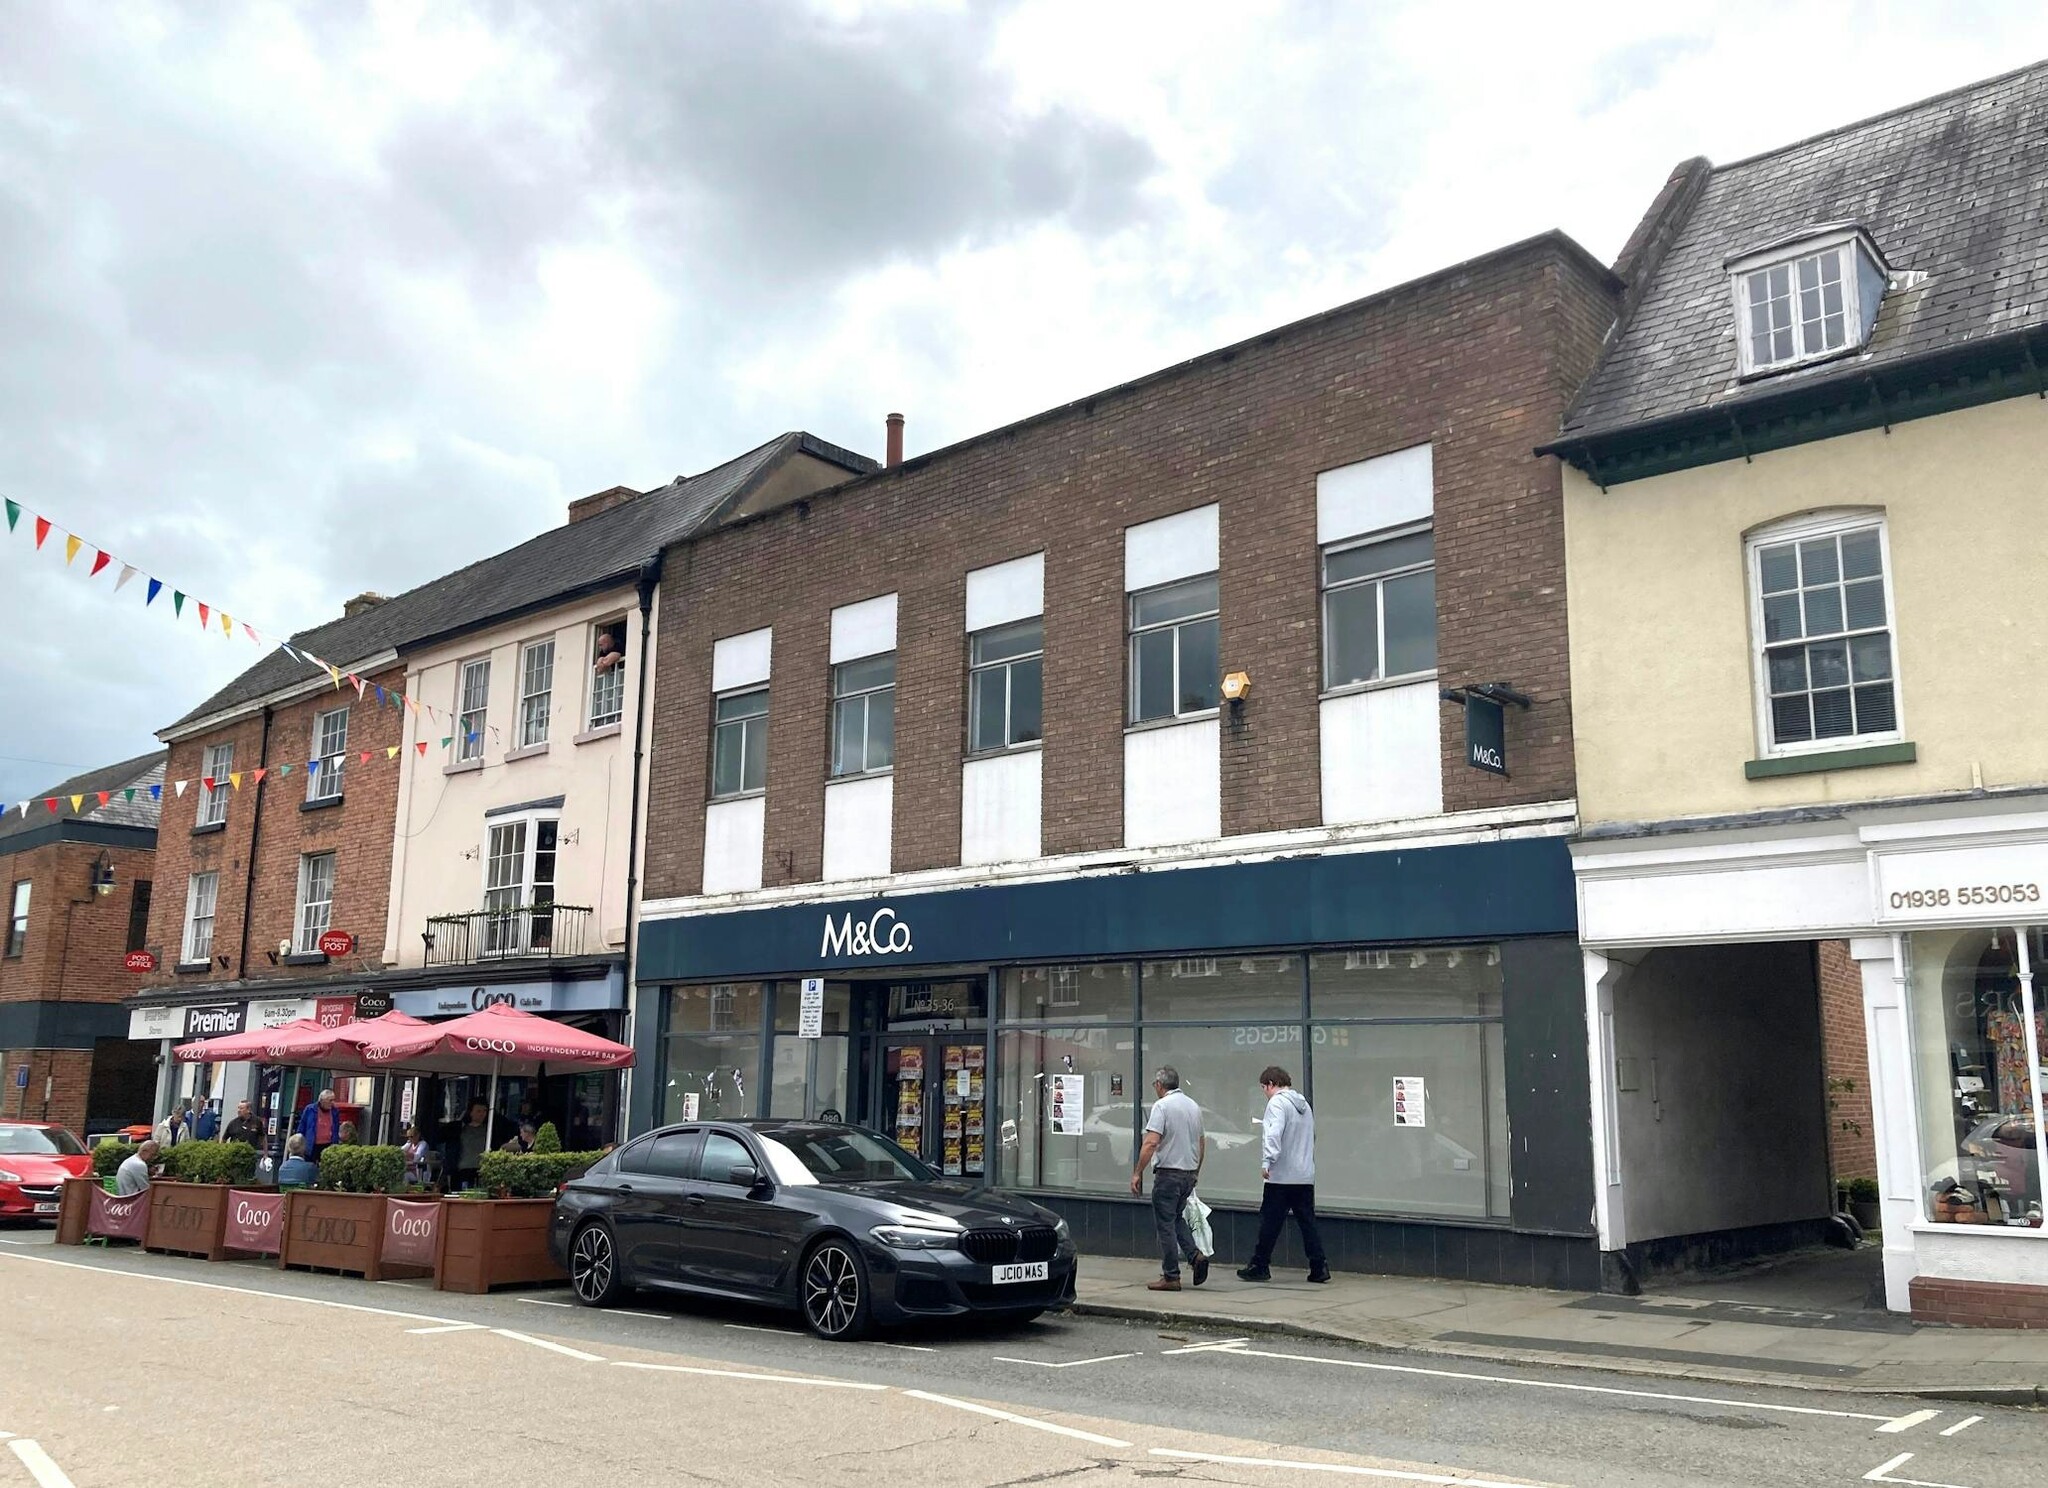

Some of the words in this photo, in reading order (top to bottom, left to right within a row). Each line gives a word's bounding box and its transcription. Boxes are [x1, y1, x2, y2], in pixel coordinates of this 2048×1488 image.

[1473, 743, 1503, 769] M&Co.
[1890, 889, 1950, 909] 01938
[1957, 883, 2041, 905] 553053
[820, 907, 914, 958] M&Co.
[324, 942, 348, 951] POST
[360, 996, 386, 1007] Coco
[471, 986, 516, 1011] Coco
[927, 999, 954, 1012] 35-36
[189, 1010, 240, 1033] Premier
[321, 1013, 342, 1027] POST
[466, 1037, 516, 1053] COCO
[527, 1044, 579, 1055] INDEPENDENT
[581, 1049, 600, 1058] CAFE
[601, 1051, 616, 1060] BAR
[103, 1197, 132, 1216] Coco
[236, 1201, 271, 1227] Coco
[391, 1209, 431, 1238] Coco
[1024, 1264, 1042, 1279] MAS
